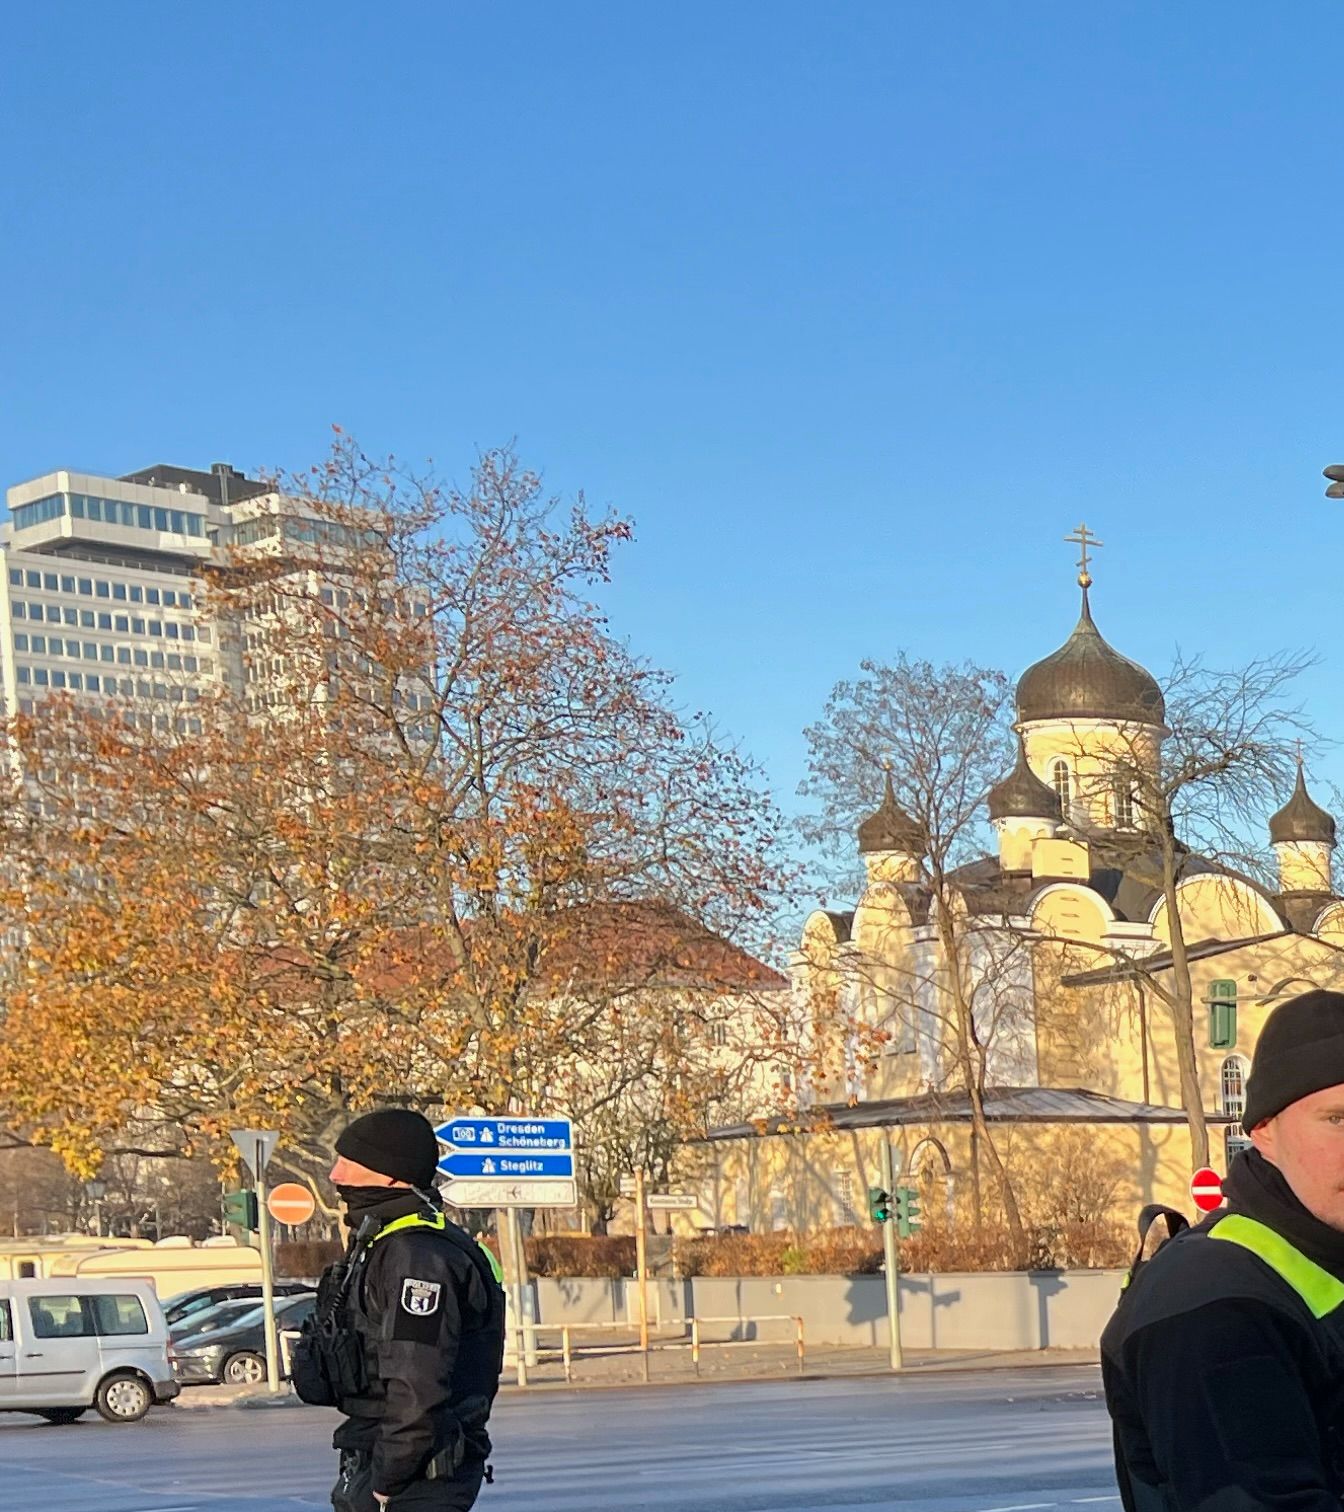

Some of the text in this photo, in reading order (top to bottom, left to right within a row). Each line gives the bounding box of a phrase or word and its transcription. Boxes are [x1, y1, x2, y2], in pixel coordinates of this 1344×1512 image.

[497, 1122, 545, 1134] Dresden
[498, 1136, 566, 1149] Schöneberg
[500, 1160, 544, 1174] Steglitz
